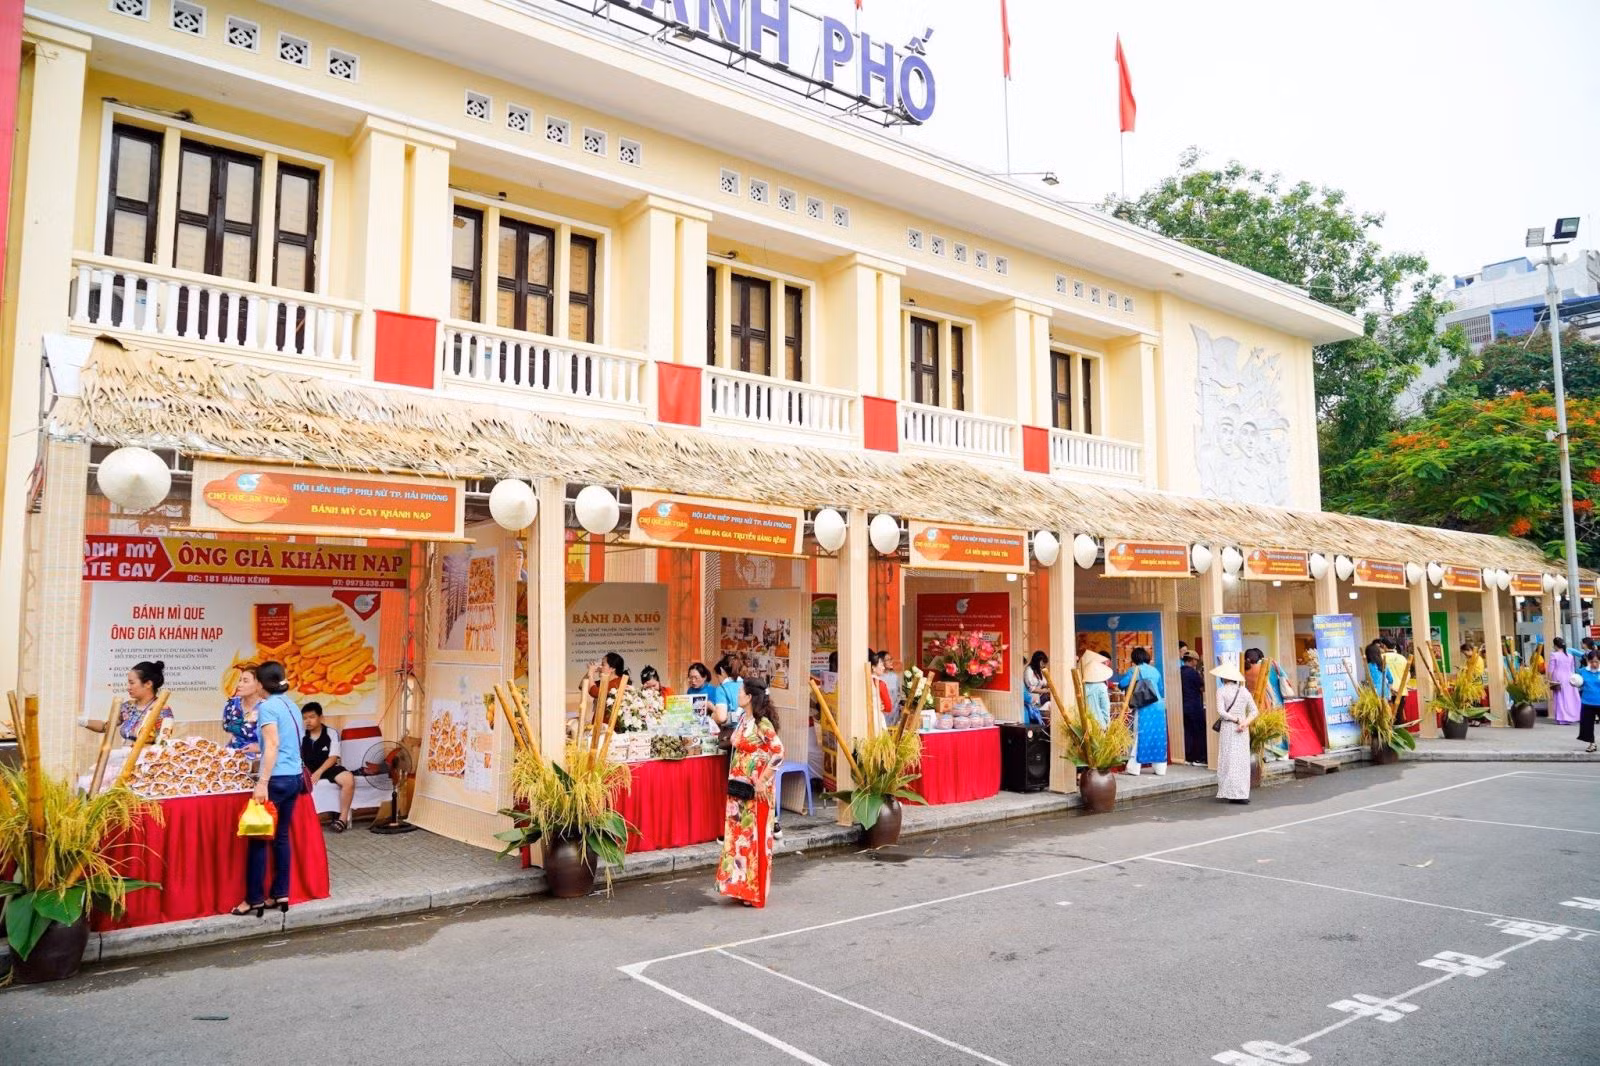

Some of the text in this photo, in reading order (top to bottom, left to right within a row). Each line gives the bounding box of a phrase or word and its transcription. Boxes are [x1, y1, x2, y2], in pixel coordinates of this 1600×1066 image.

[821, 16, 936, 122] PHỐ
[208, 491, 226, 501] CHỢ
[293, 483, 448, 502] HỘI LIÊN HIỆP PHỤ NỮ TP. HẢI PHÒNG
[311, 504, 432, 521] BÁNH MỲ CAY KHÁNH NẠP
[126, 541, 157, 558] MỲ
[178, 540, 404, 577] ÔNG GIÀ KHÁNH NẠP
[118, 562, 156, 578] CAY
[204, 575, 220, 583] 181
[222, 574, 245, 583] HÀNG
[248, 576, 270, 584] KÊNH
[132, 604, 205, 620] BÁNH MÌ QUE
[572, 611, 661, 623] BÁNH ĐA KHÔ
[111, 624, 223, 643] ÔNG GIÀ KHÁNH NẠP
